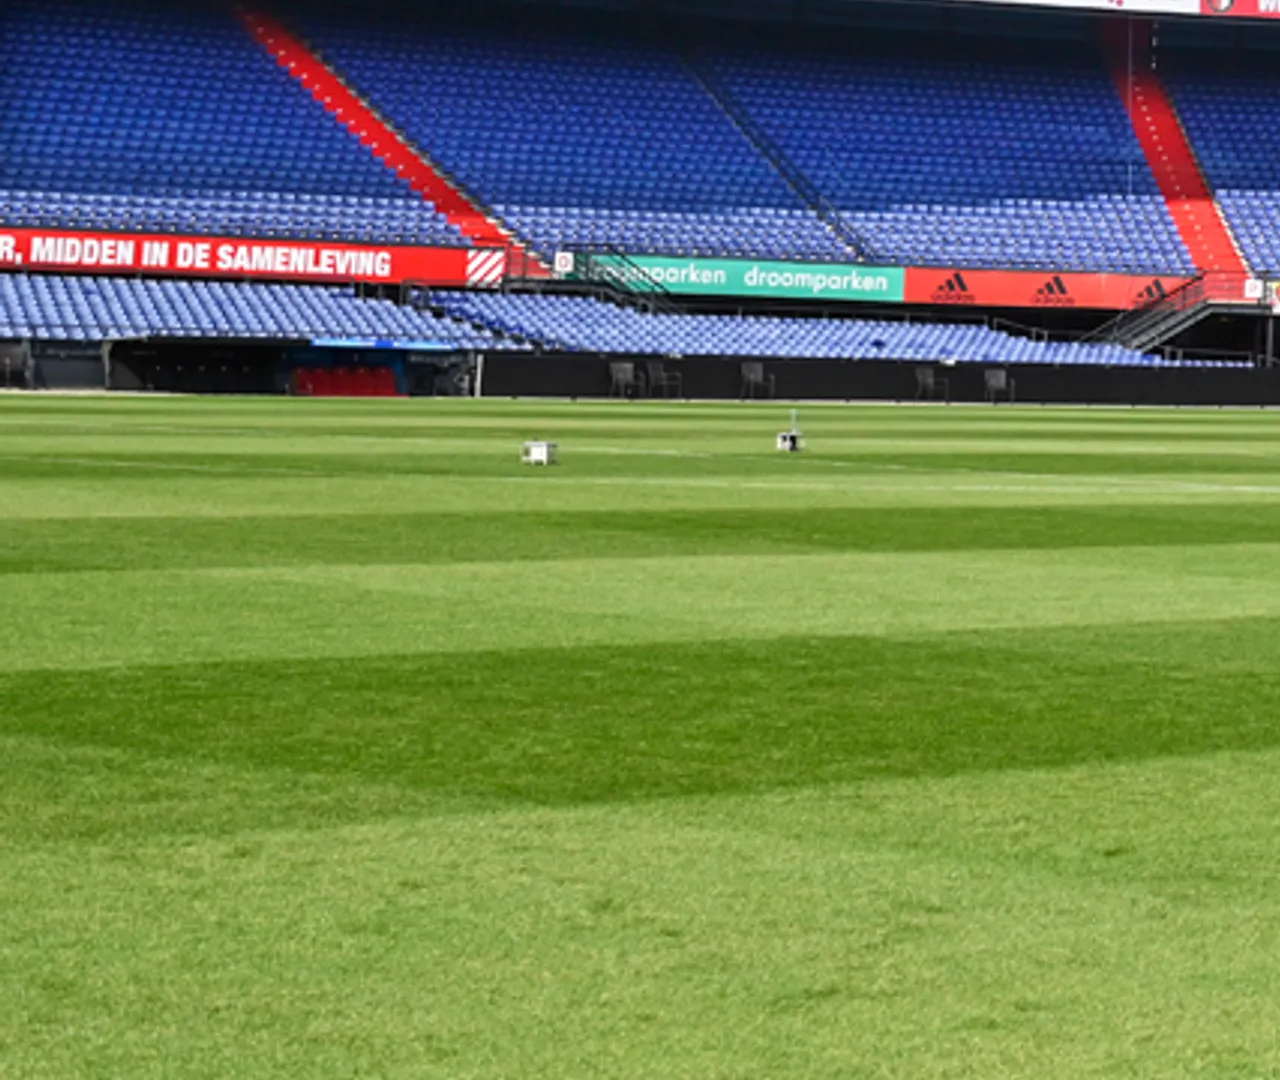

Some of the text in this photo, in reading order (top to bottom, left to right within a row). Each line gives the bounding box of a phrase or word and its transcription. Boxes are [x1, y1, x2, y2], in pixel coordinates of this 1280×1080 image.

[30, 236, 134, 267] MIDDEN
[141, 241, 169, 268] IN
[176, 242, 211, 269] DE
[216, 244, 391, 277] SAMENLEVING
[743, 265, 888, 294] droomparken
